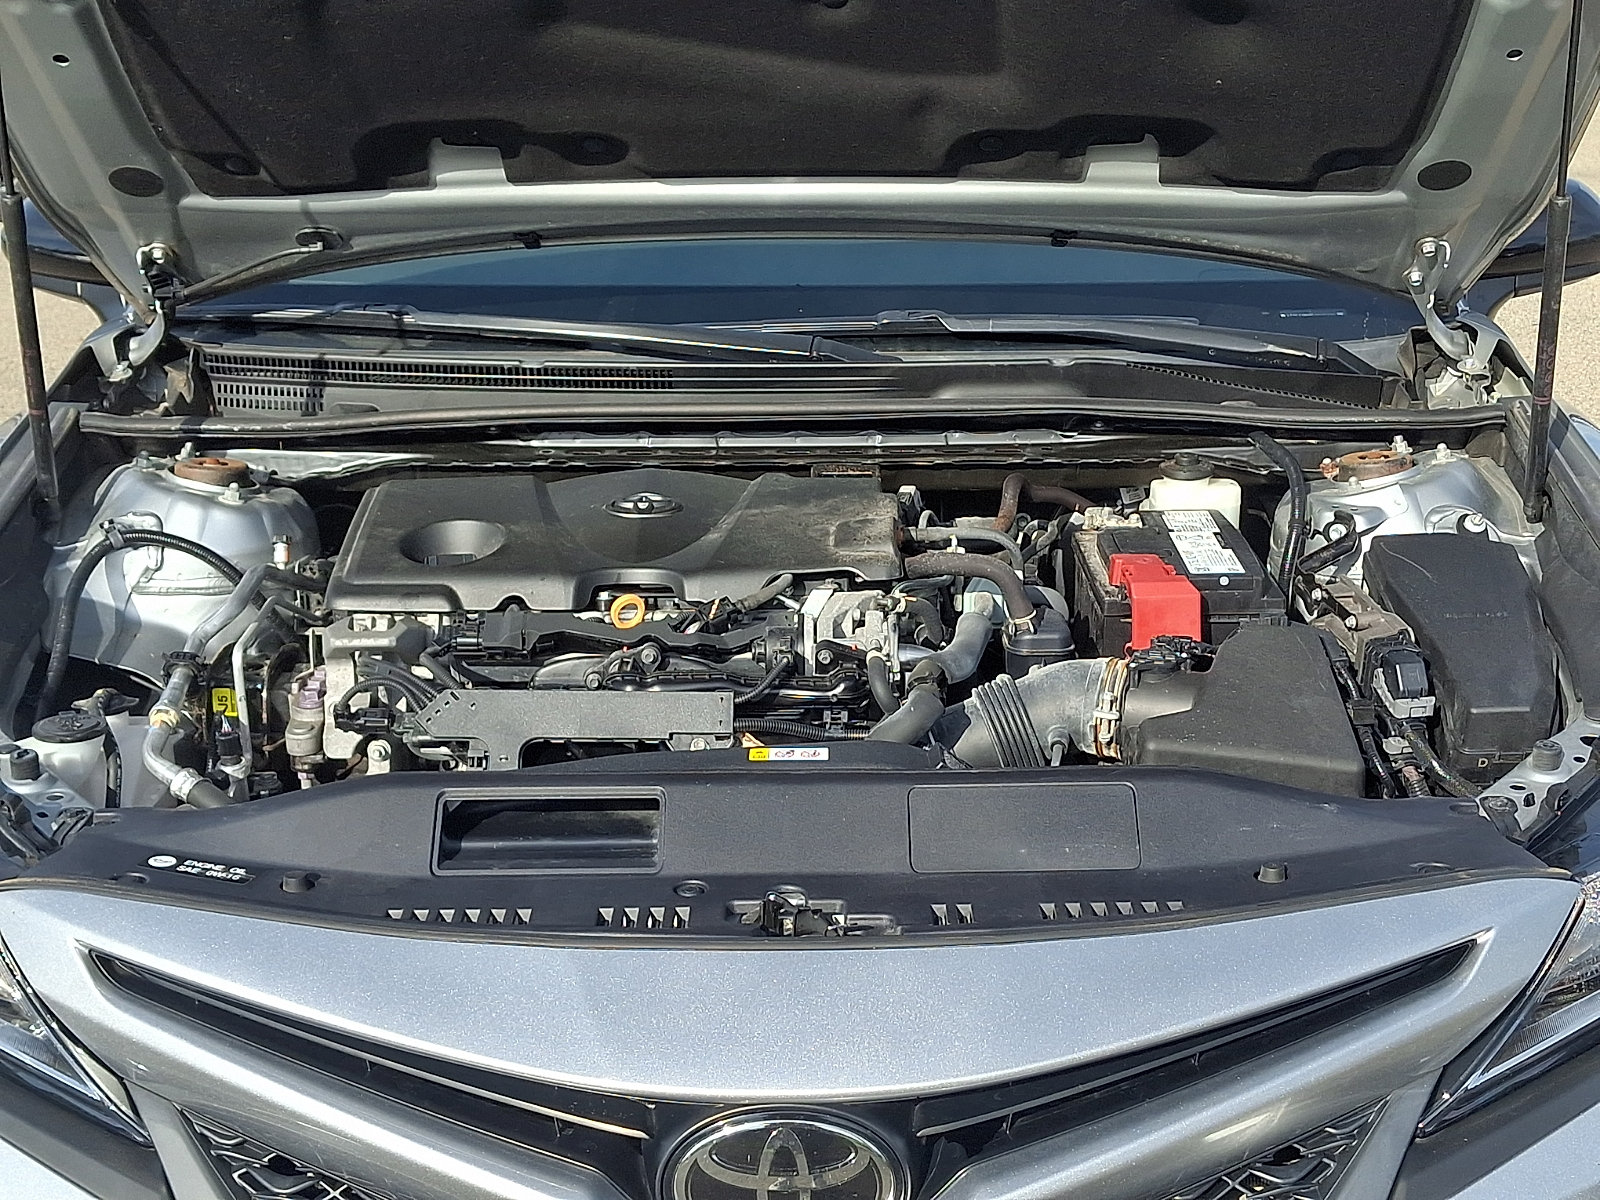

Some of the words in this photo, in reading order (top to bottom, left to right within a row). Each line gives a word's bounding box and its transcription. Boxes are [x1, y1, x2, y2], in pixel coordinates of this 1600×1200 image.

[176, 865, 201, 874] SAE
[183, 859, 226, 871] ENGINE
[229, 866, 247, 875] OIL
